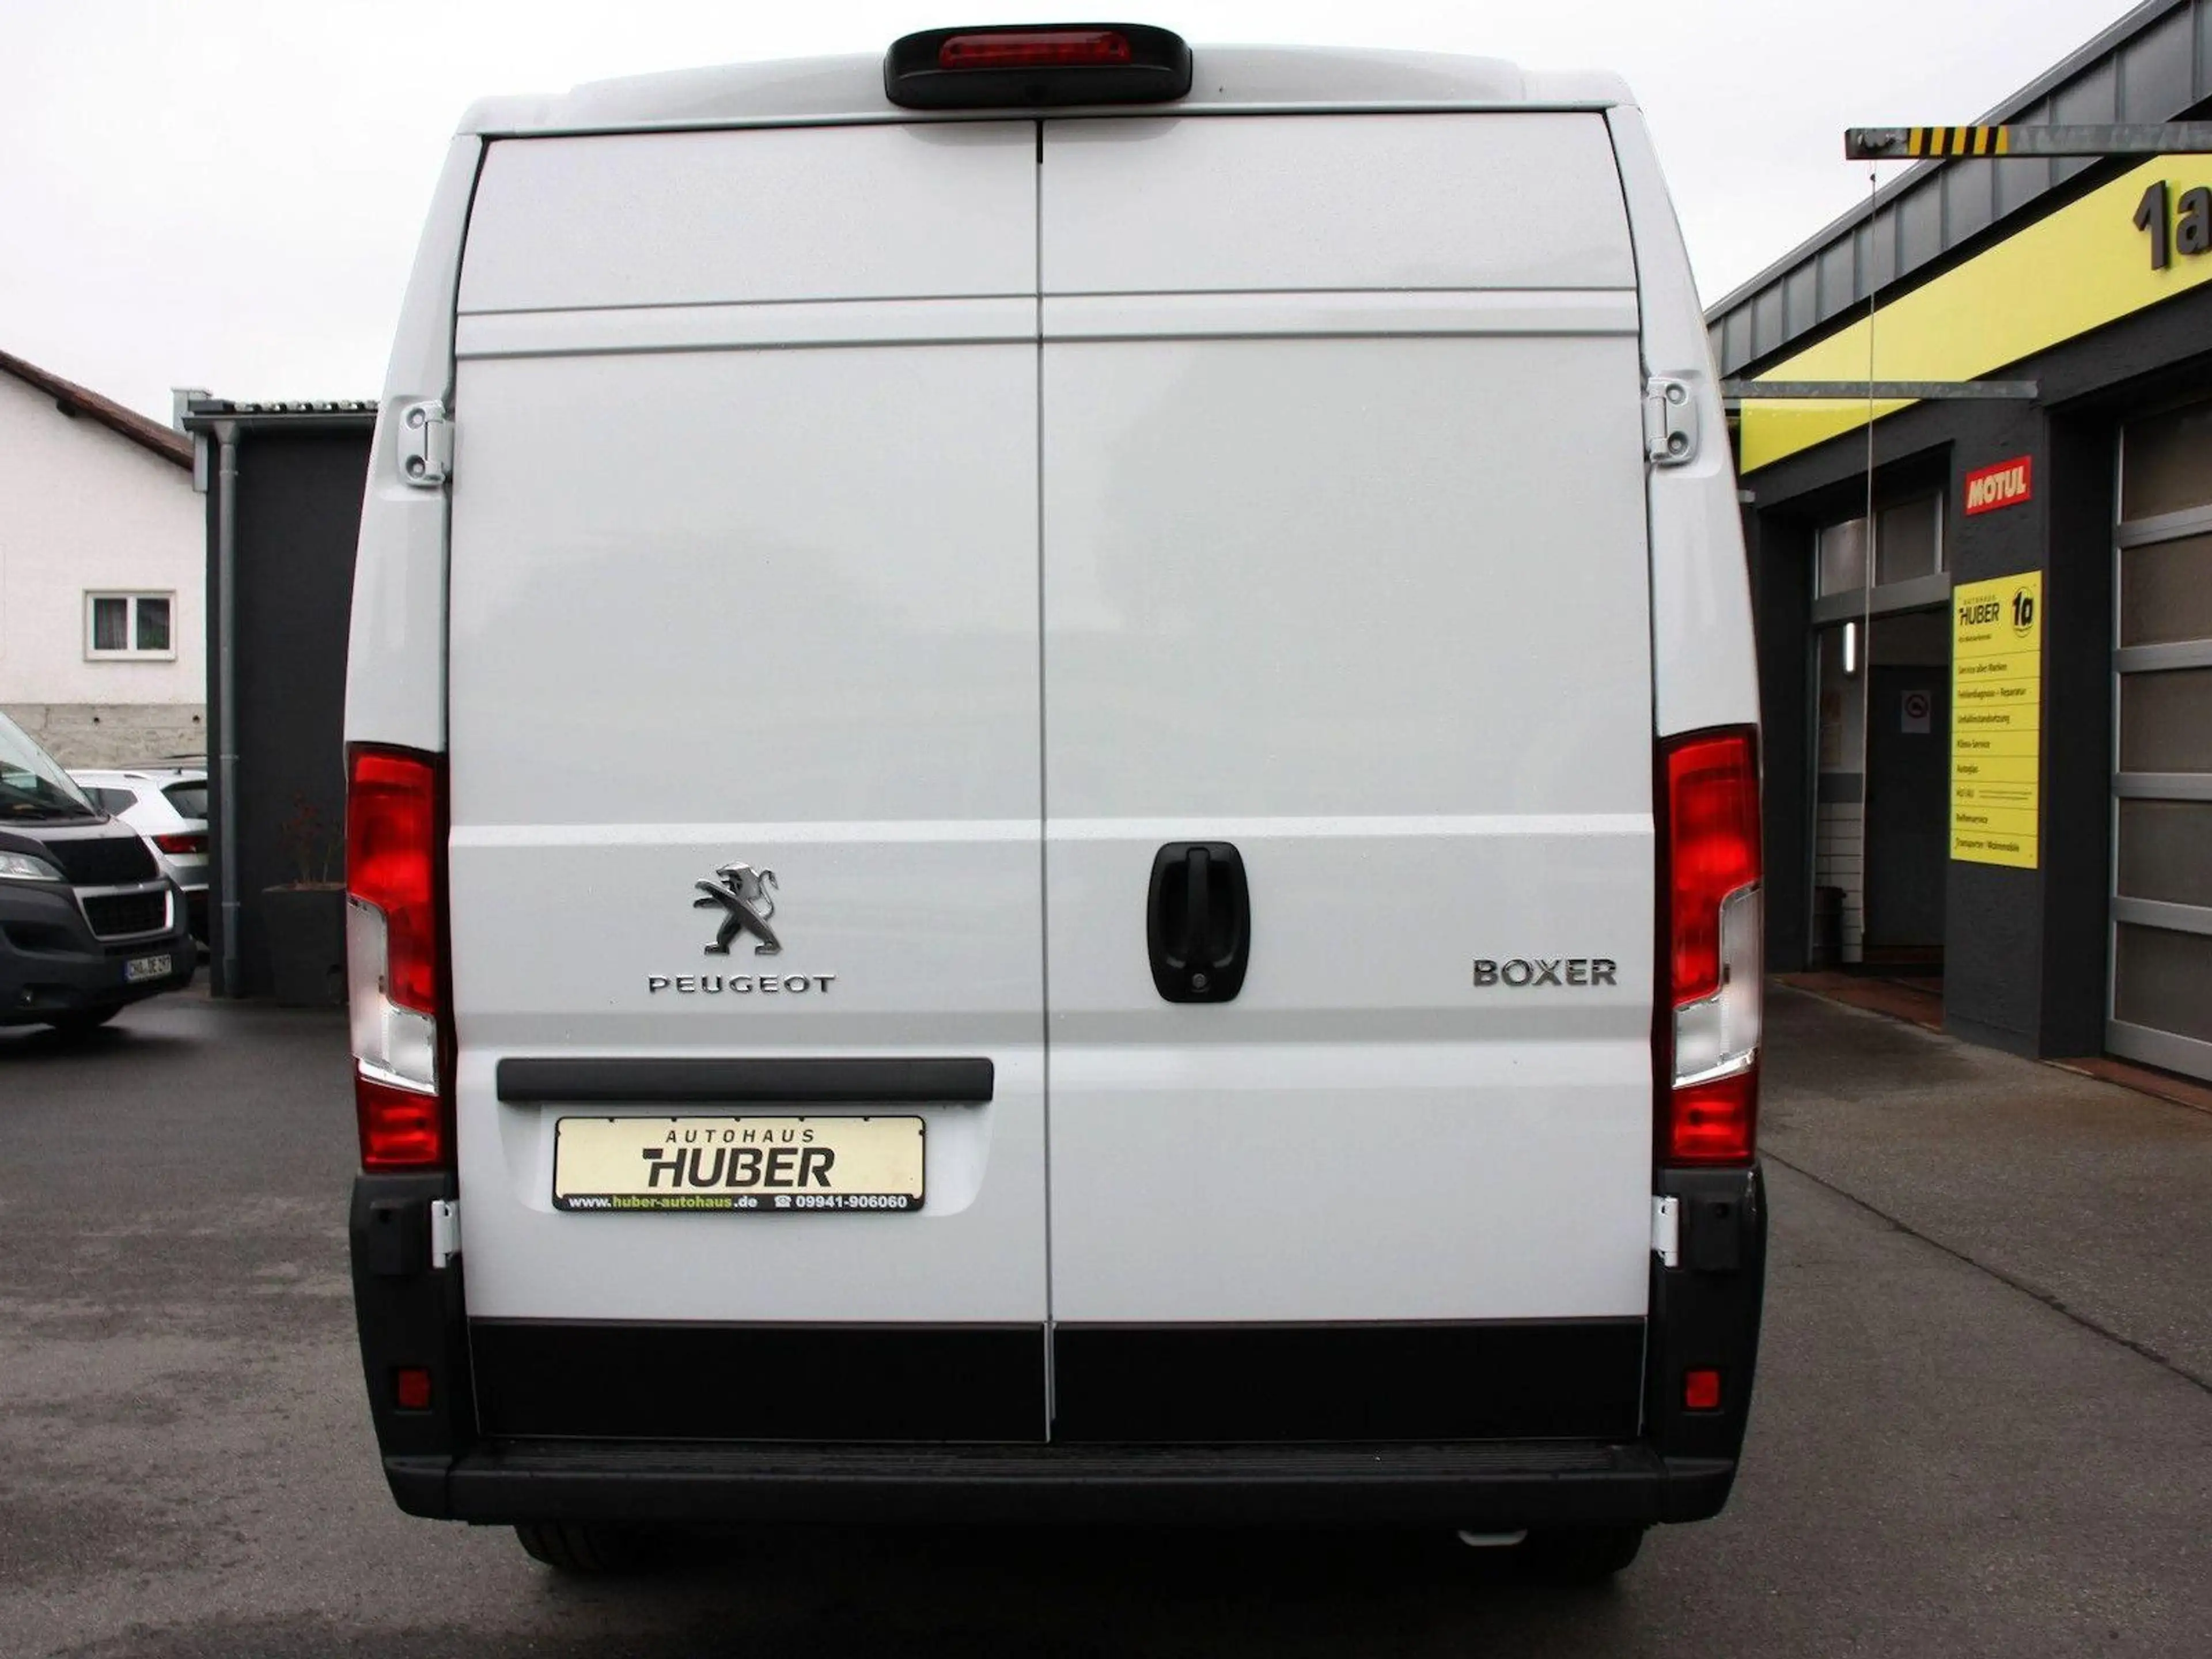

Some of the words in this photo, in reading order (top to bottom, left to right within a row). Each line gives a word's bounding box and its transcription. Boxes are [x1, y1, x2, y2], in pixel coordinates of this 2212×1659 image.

[2133, 180, 2212, 271] 1a
[1967, 465, 2027, 508] MOTUL
[1959, 603, 2000, 626] HUBER
[2012, 591, 2033, 626] 1a
[648, 975, 836, 993] PEUGEOT
[1473, 959, 1616, 987] BOXER
[665, 1128, 815, 1143] AUTOHAUS
[642, 1147, 835, 1187] HUBER
[569, 1195, 757, 1209] www.huber-autohaus.de
[796, 1195, 908, 1209] 09941-906060
